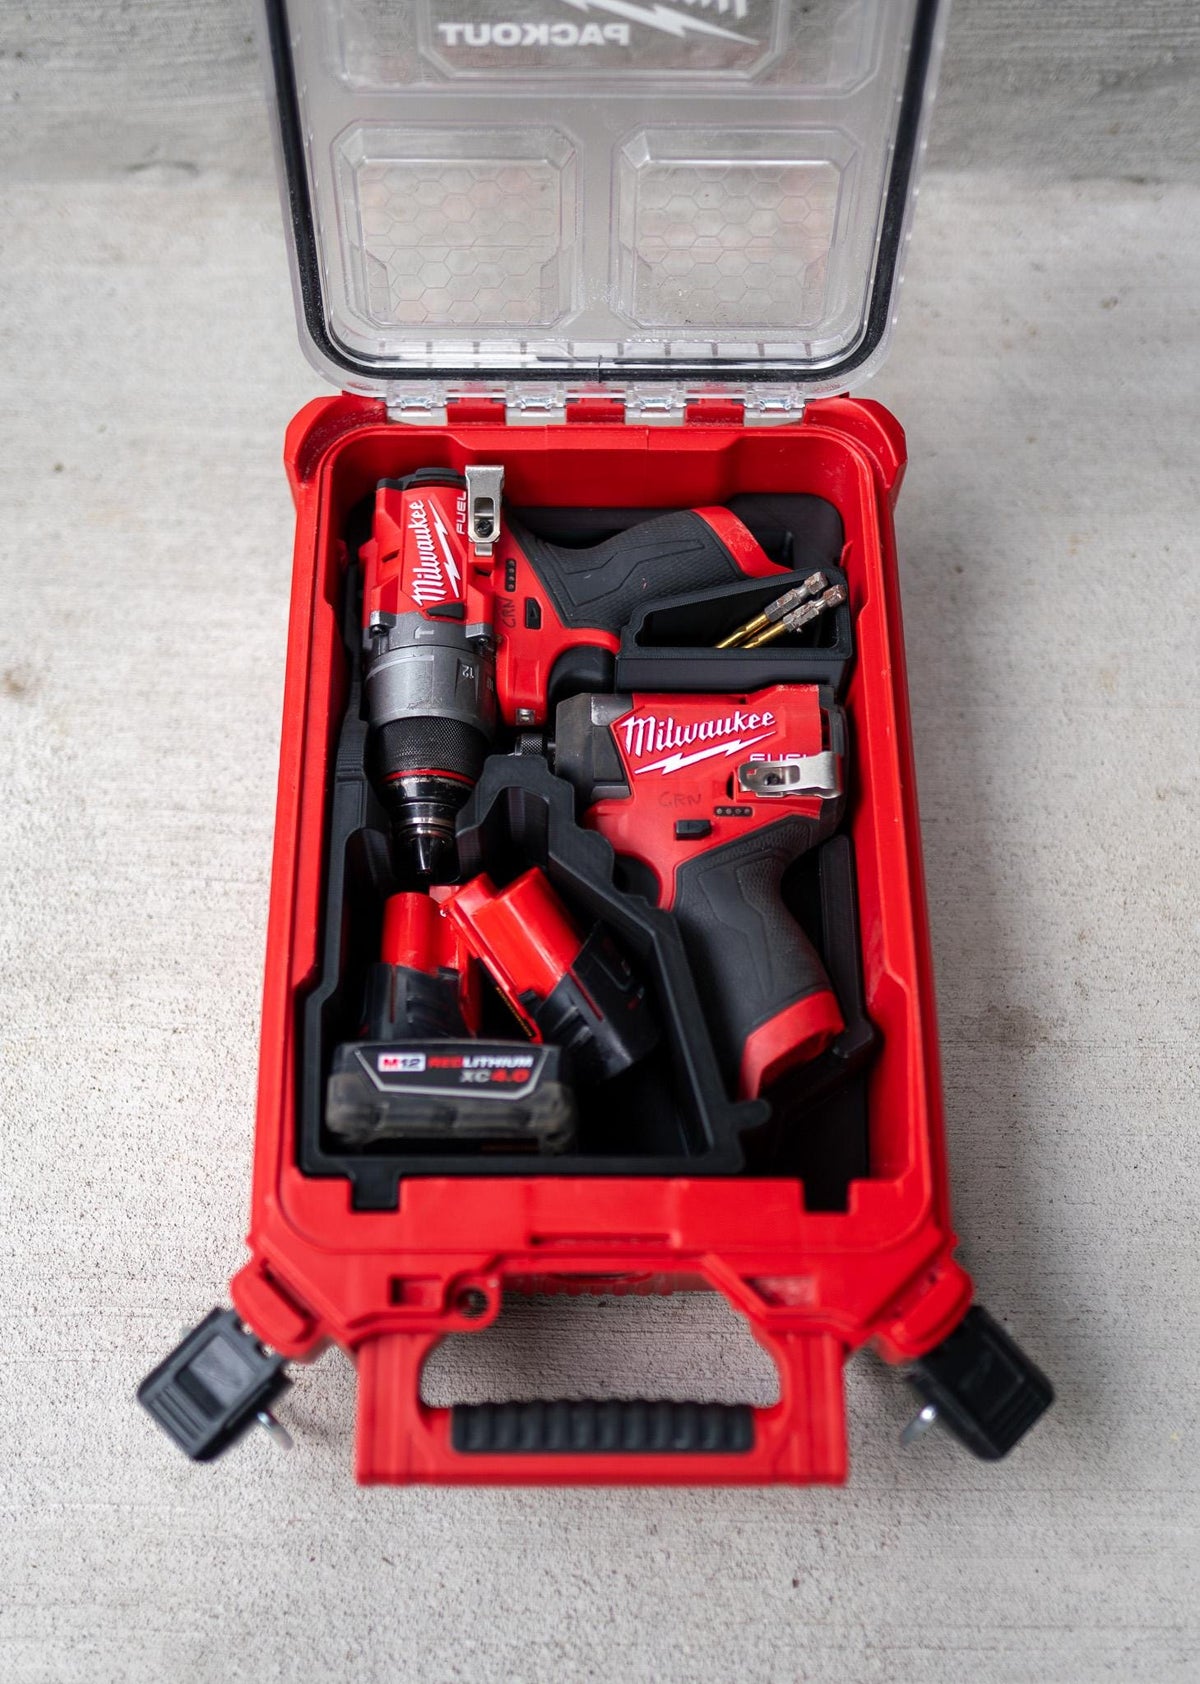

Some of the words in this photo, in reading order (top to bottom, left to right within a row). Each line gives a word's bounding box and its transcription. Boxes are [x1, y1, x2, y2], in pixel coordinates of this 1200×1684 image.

[456, 491, 467, 535] FUEL
[407, 500, 447, 606] Milwaukee
[461, 664, 475, 679] 12
[620, 711, 776, 757] Milwaukee
[382, 1057, 421, 1069] M12
